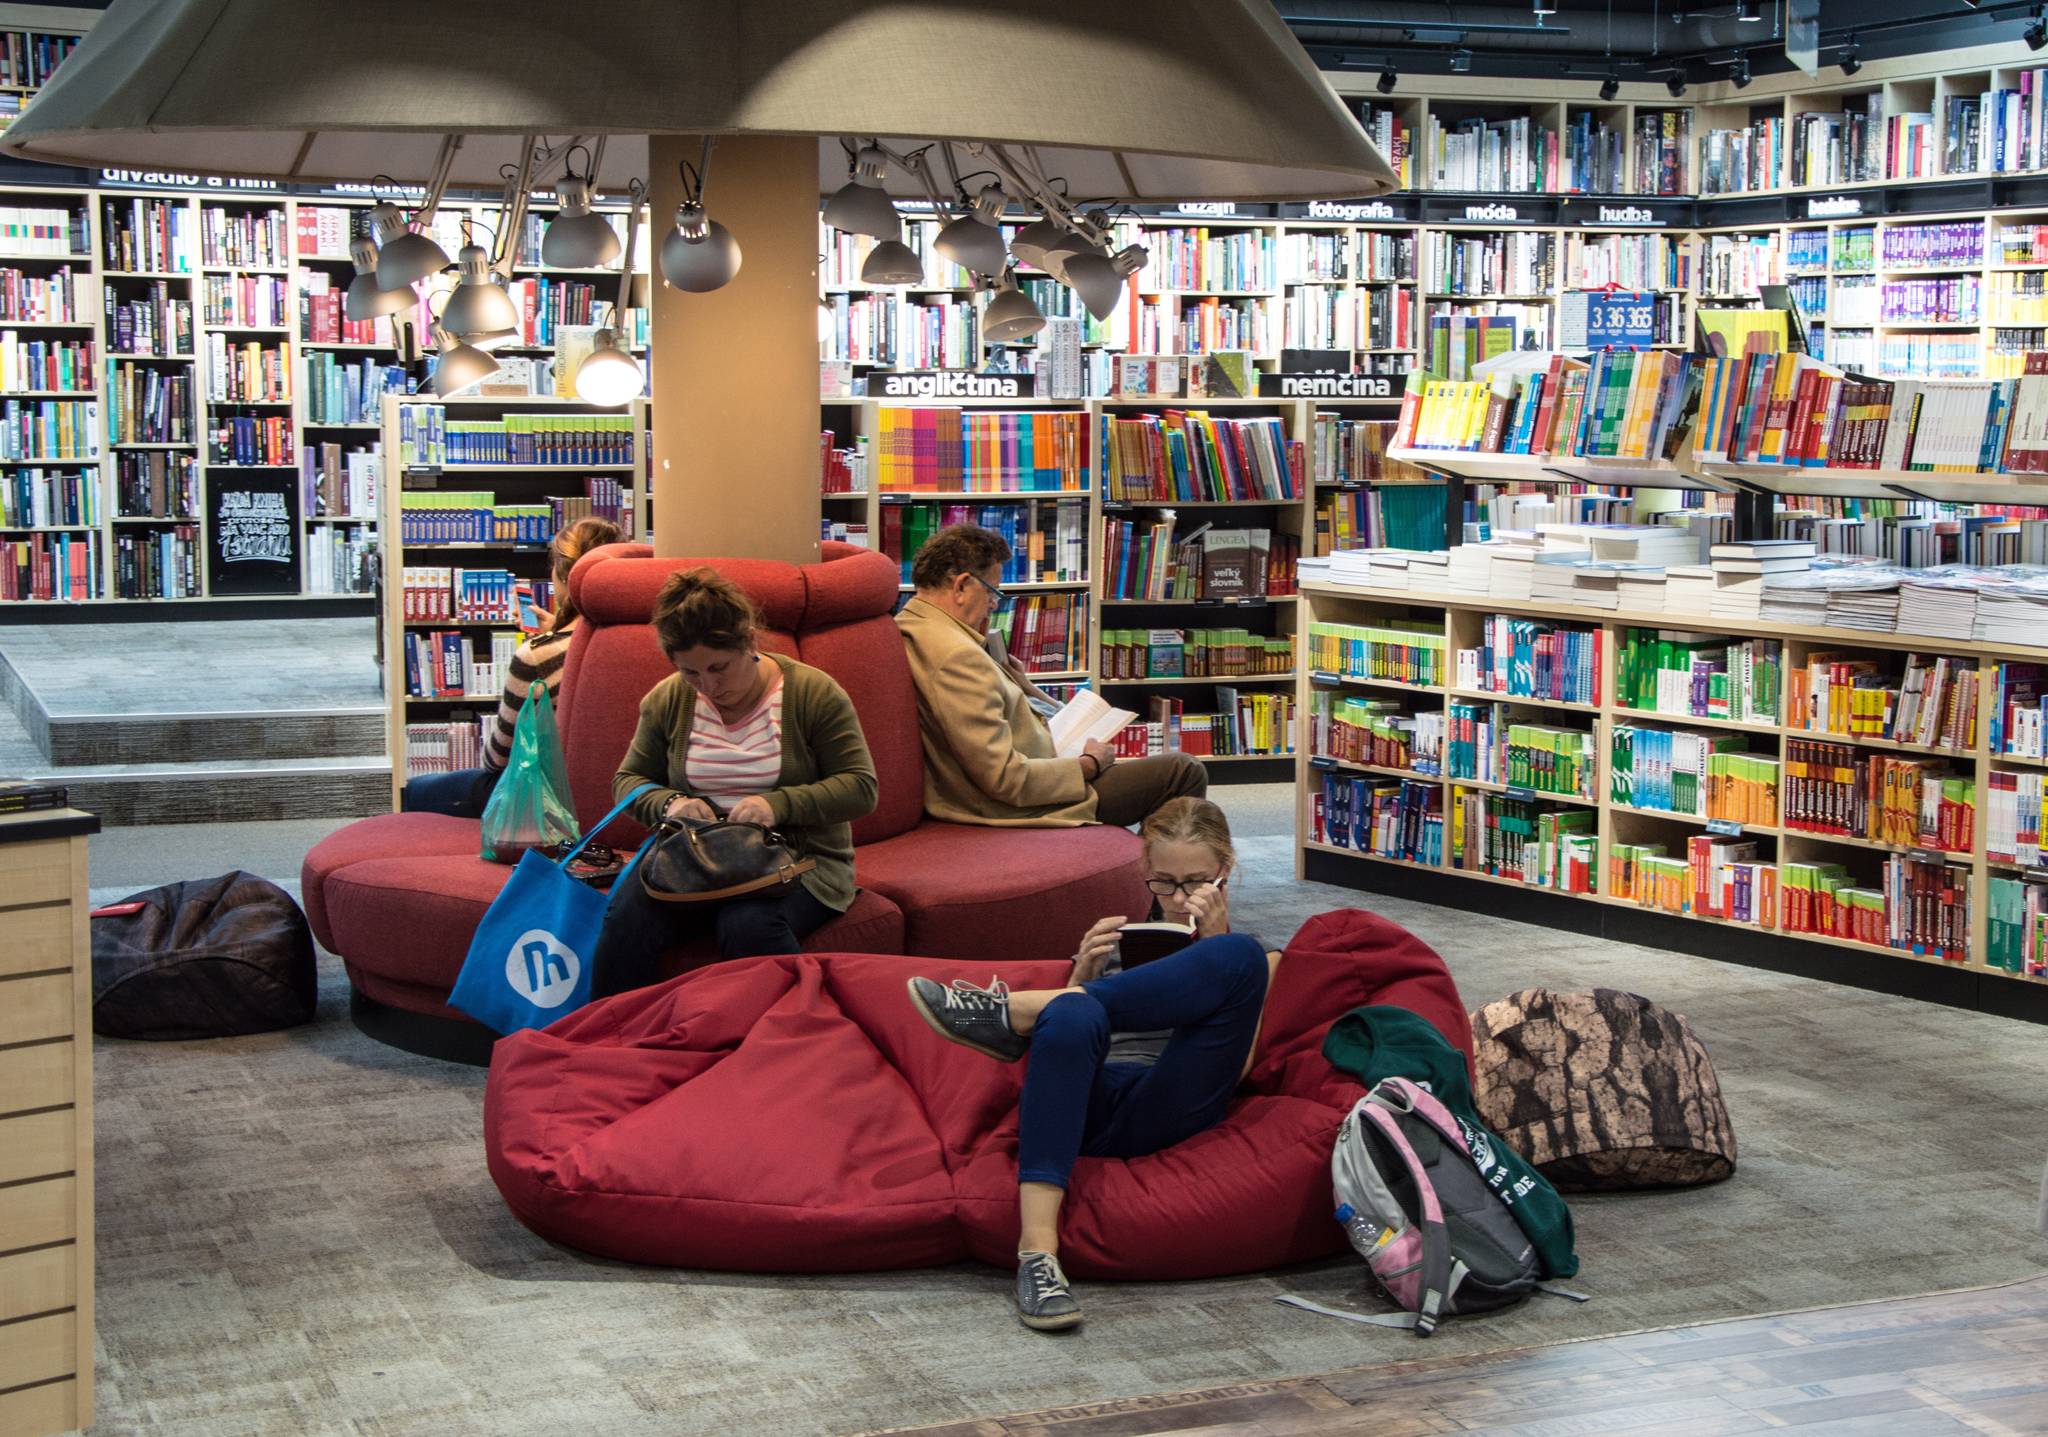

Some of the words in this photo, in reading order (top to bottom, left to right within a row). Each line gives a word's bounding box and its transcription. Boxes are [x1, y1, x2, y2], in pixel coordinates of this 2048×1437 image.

[1393, 136, 1402, 177] ARAKI
[1308, 201, 1394, 221] fotografia
[1465, 203, 1517, 221] móda
[1599, 205, 1653, 222] hudba
[1592, 306, 1603, 328] 3
[885, 372, 1018, 399] angličtina
[1282, 373, 1391, 397] nemčina
[1209, 536, 1247, 545] LINGEA
[1210, 578, 1244, 588] slovník
[1214, 567, 1241, 580] veľký
